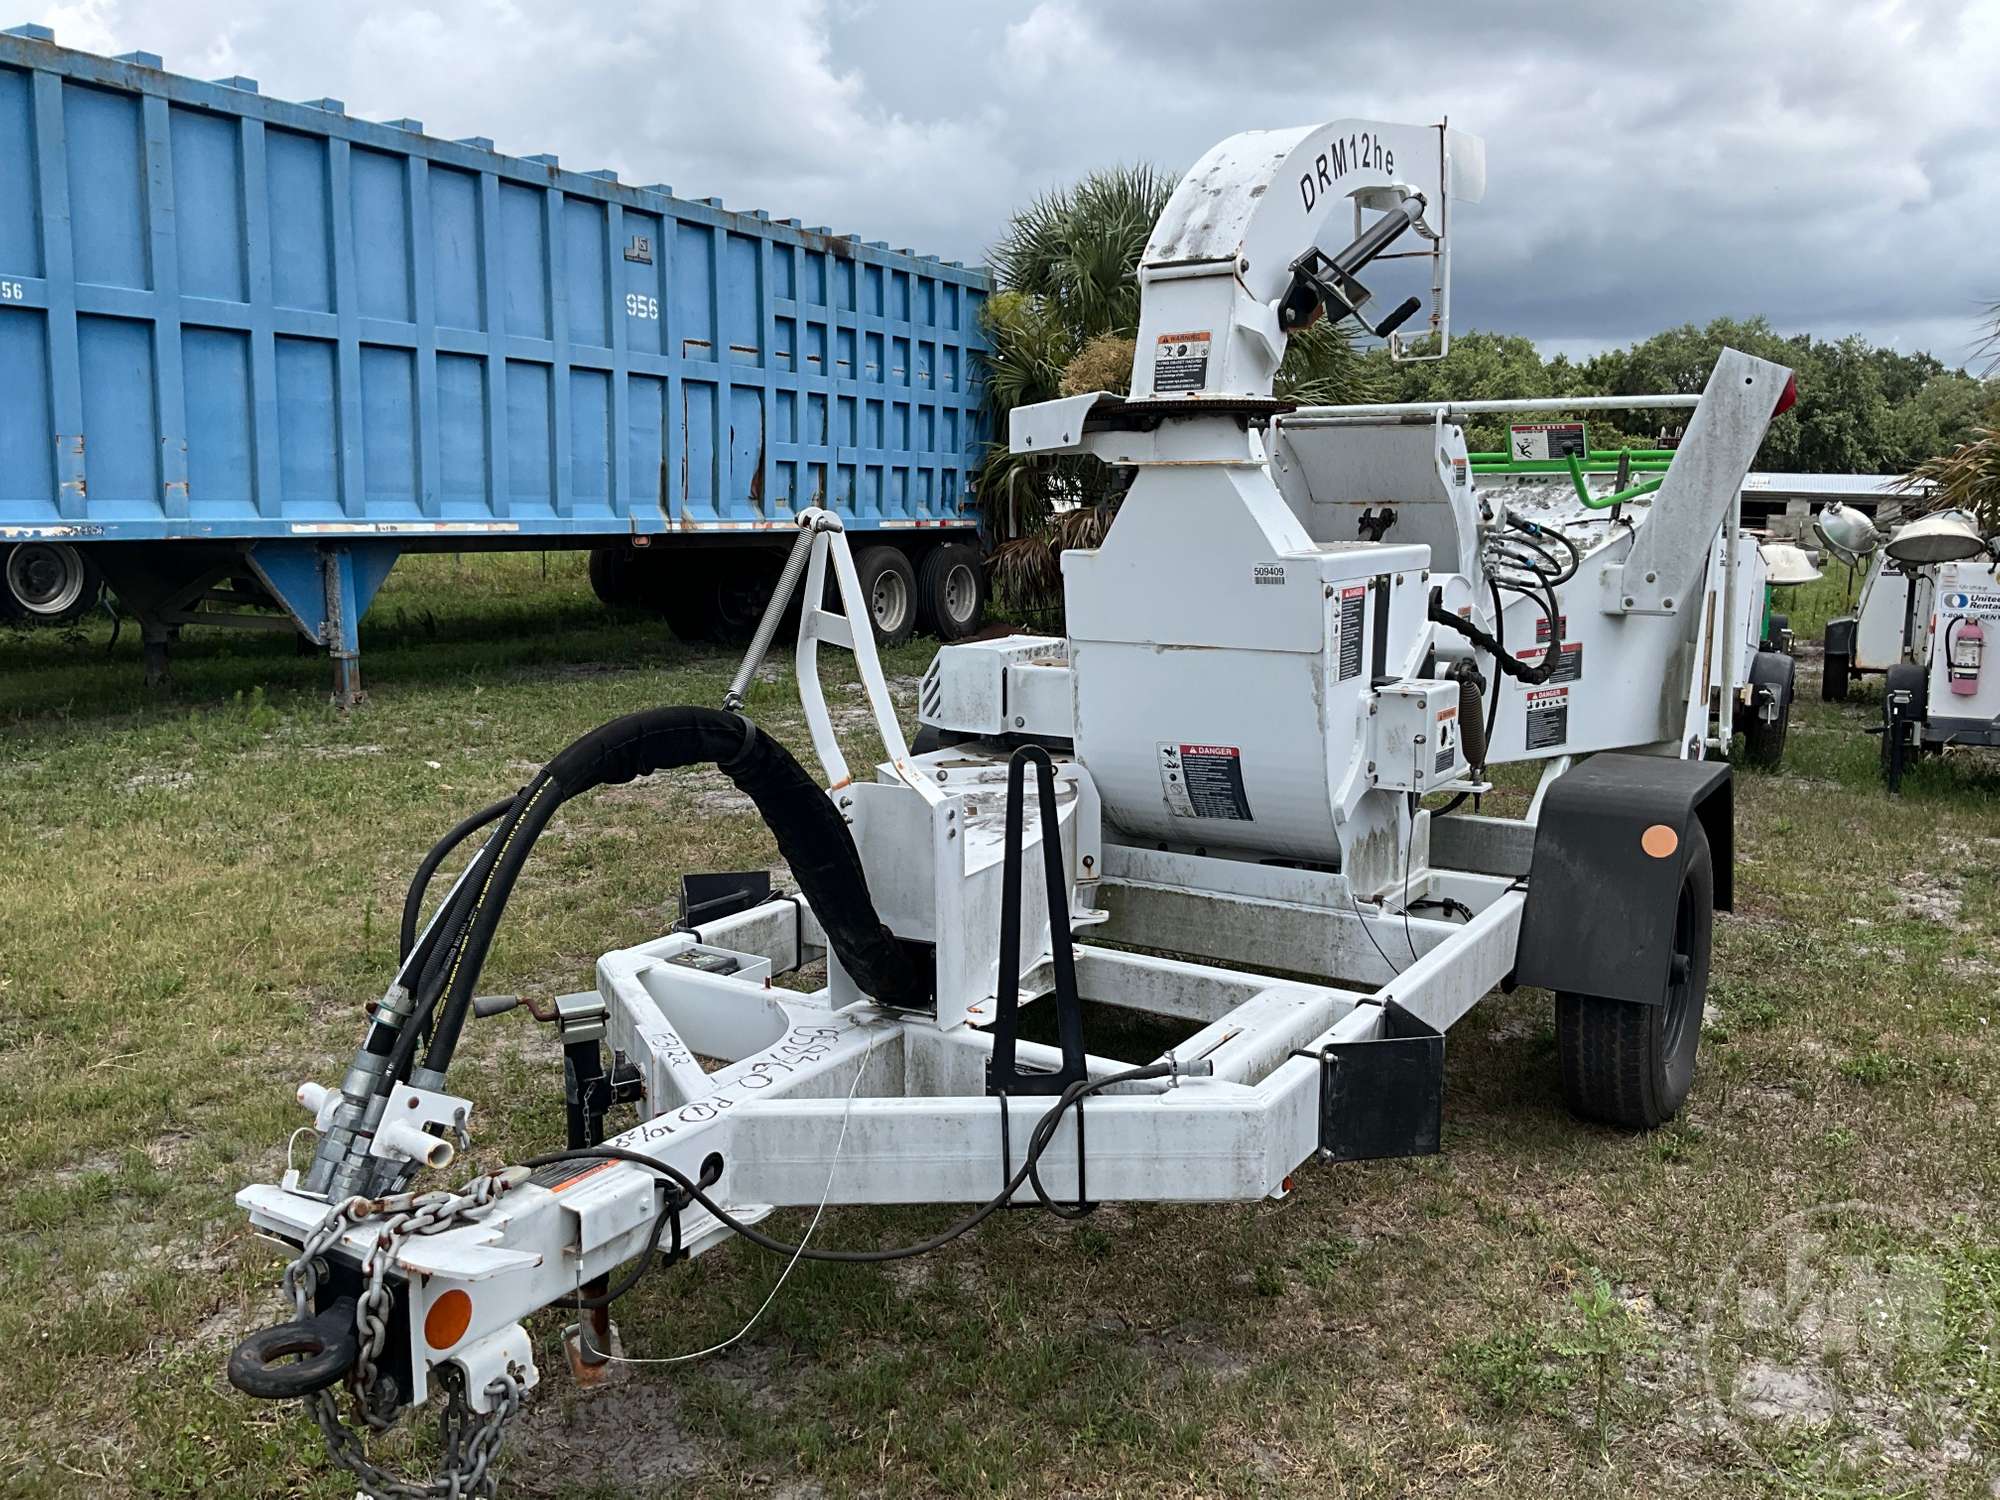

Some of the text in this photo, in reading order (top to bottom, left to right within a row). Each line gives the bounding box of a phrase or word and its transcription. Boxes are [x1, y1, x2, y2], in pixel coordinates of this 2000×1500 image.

[1300, 132, 1394, 215] DRM12he
[626, 294, 658, 320] 956
[1254, 567, 1284, 577] 509409
[1198, 746, 1232, 756] DANGER
